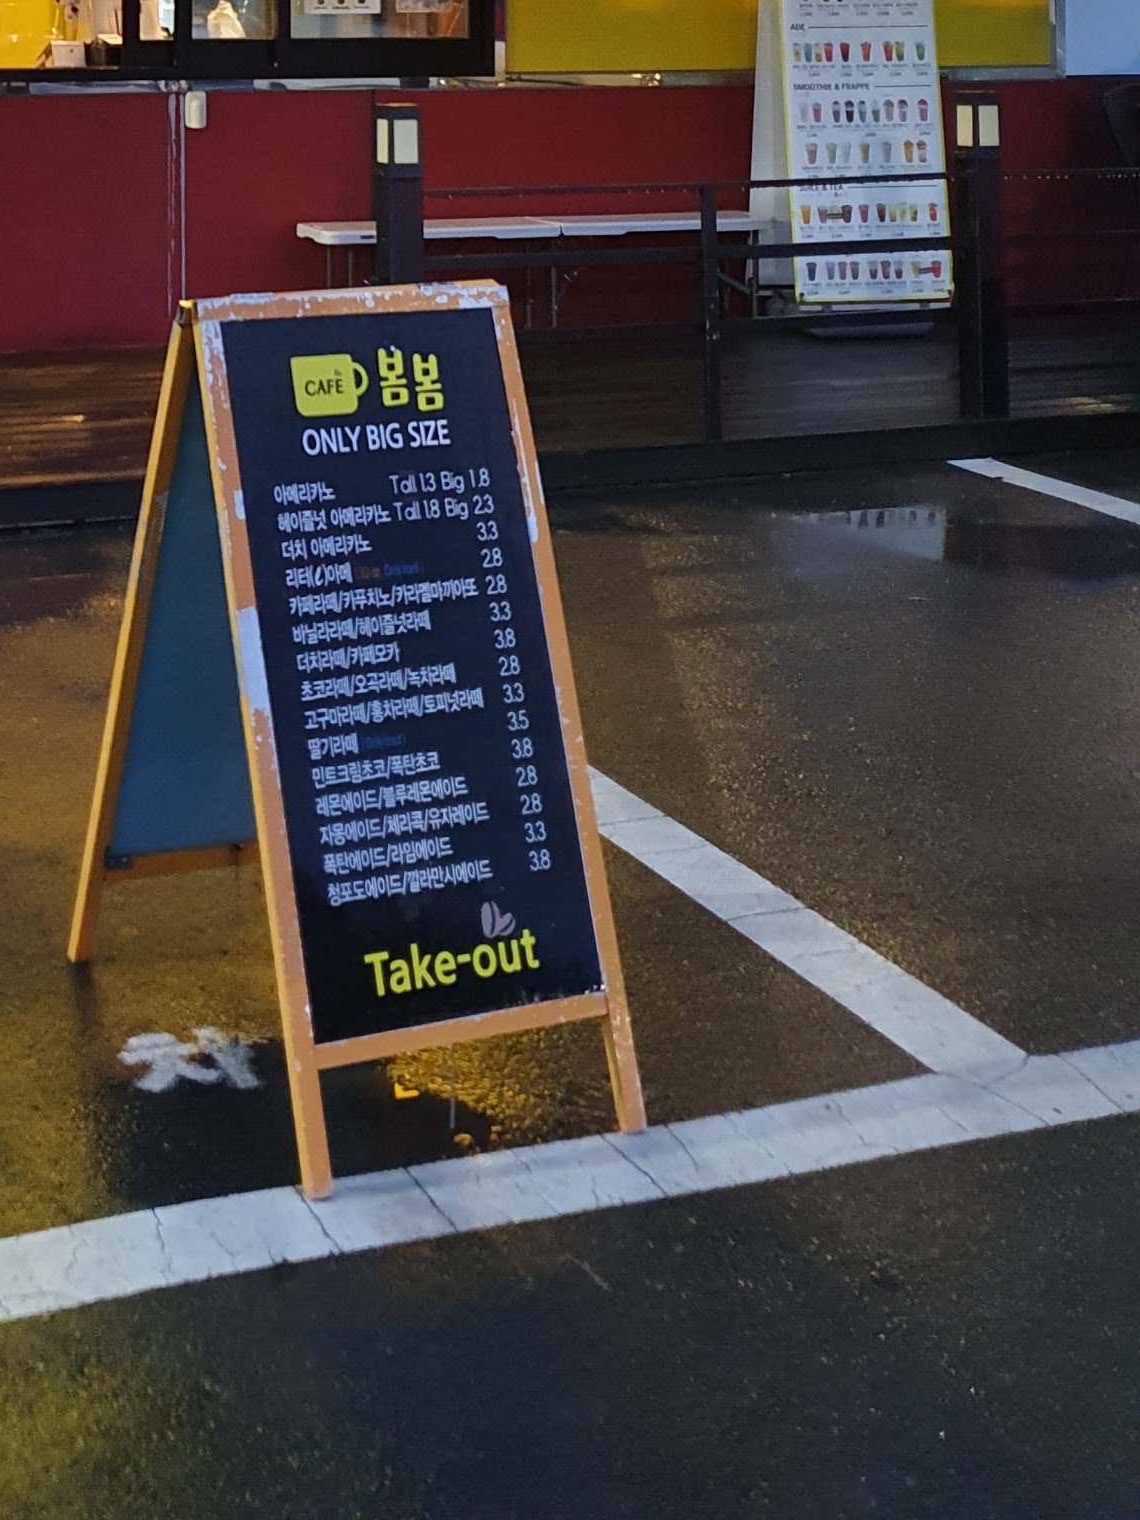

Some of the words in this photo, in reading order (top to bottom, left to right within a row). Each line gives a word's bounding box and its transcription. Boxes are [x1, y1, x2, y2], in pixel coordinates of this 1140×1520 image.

[790, 23, 806, 31] ADE
[793, 83, 831, 91] SMOOTHIE
[841, 82, 870, 90] FRAPPE
[304, 378, 344, 397] CAFE
[377, 346, 445, 412] 봄봄
[302, 425, 361, 456] ONLY
[366, 423, 404, 452] BIG
[409, 419, 451, 447] SIZE
[273, 481, 336, 505] 아메리카노
[388, 473, 417, 495] Tall
[440, 469, 465, 493] Big
[468, 467, 490, 488] 1.8
[277, 508, 327, 533] 헤이즐넛
[330, 504, 392, 528] 아메리카노
[392, 500, 422, 522] Tall
[444, 497, 469, 521] Big
[473, 494, 495, 515] 2.3
[281, 539, 307, 562] 더치
[310, 534, 372, 559] 아메리카노
[476, 520, 498, 541] 3.3
[480, 547, 503, 568] 2.8
[485, 574, 507, 595] 2.8
[489, 601, 512, 621] 3.3
[494, 628, 516, 649] 3.8
[499, 655, 521, 676] 2.8
[503, 683, 525, 703] 3.3
[307, 732, 359, 760] 딸기라떼
[507, 710, 529, 730] 3.5
[512, 738, 534, 758] 3.8
[515, 766, 538, 788] 2.8
[520, 793, 543, 815] 2.8
[524, 821, 547, 843] 3.3
[528, 849, 552, 871] 3.8
[364, 929, 540, 997] Take-out
